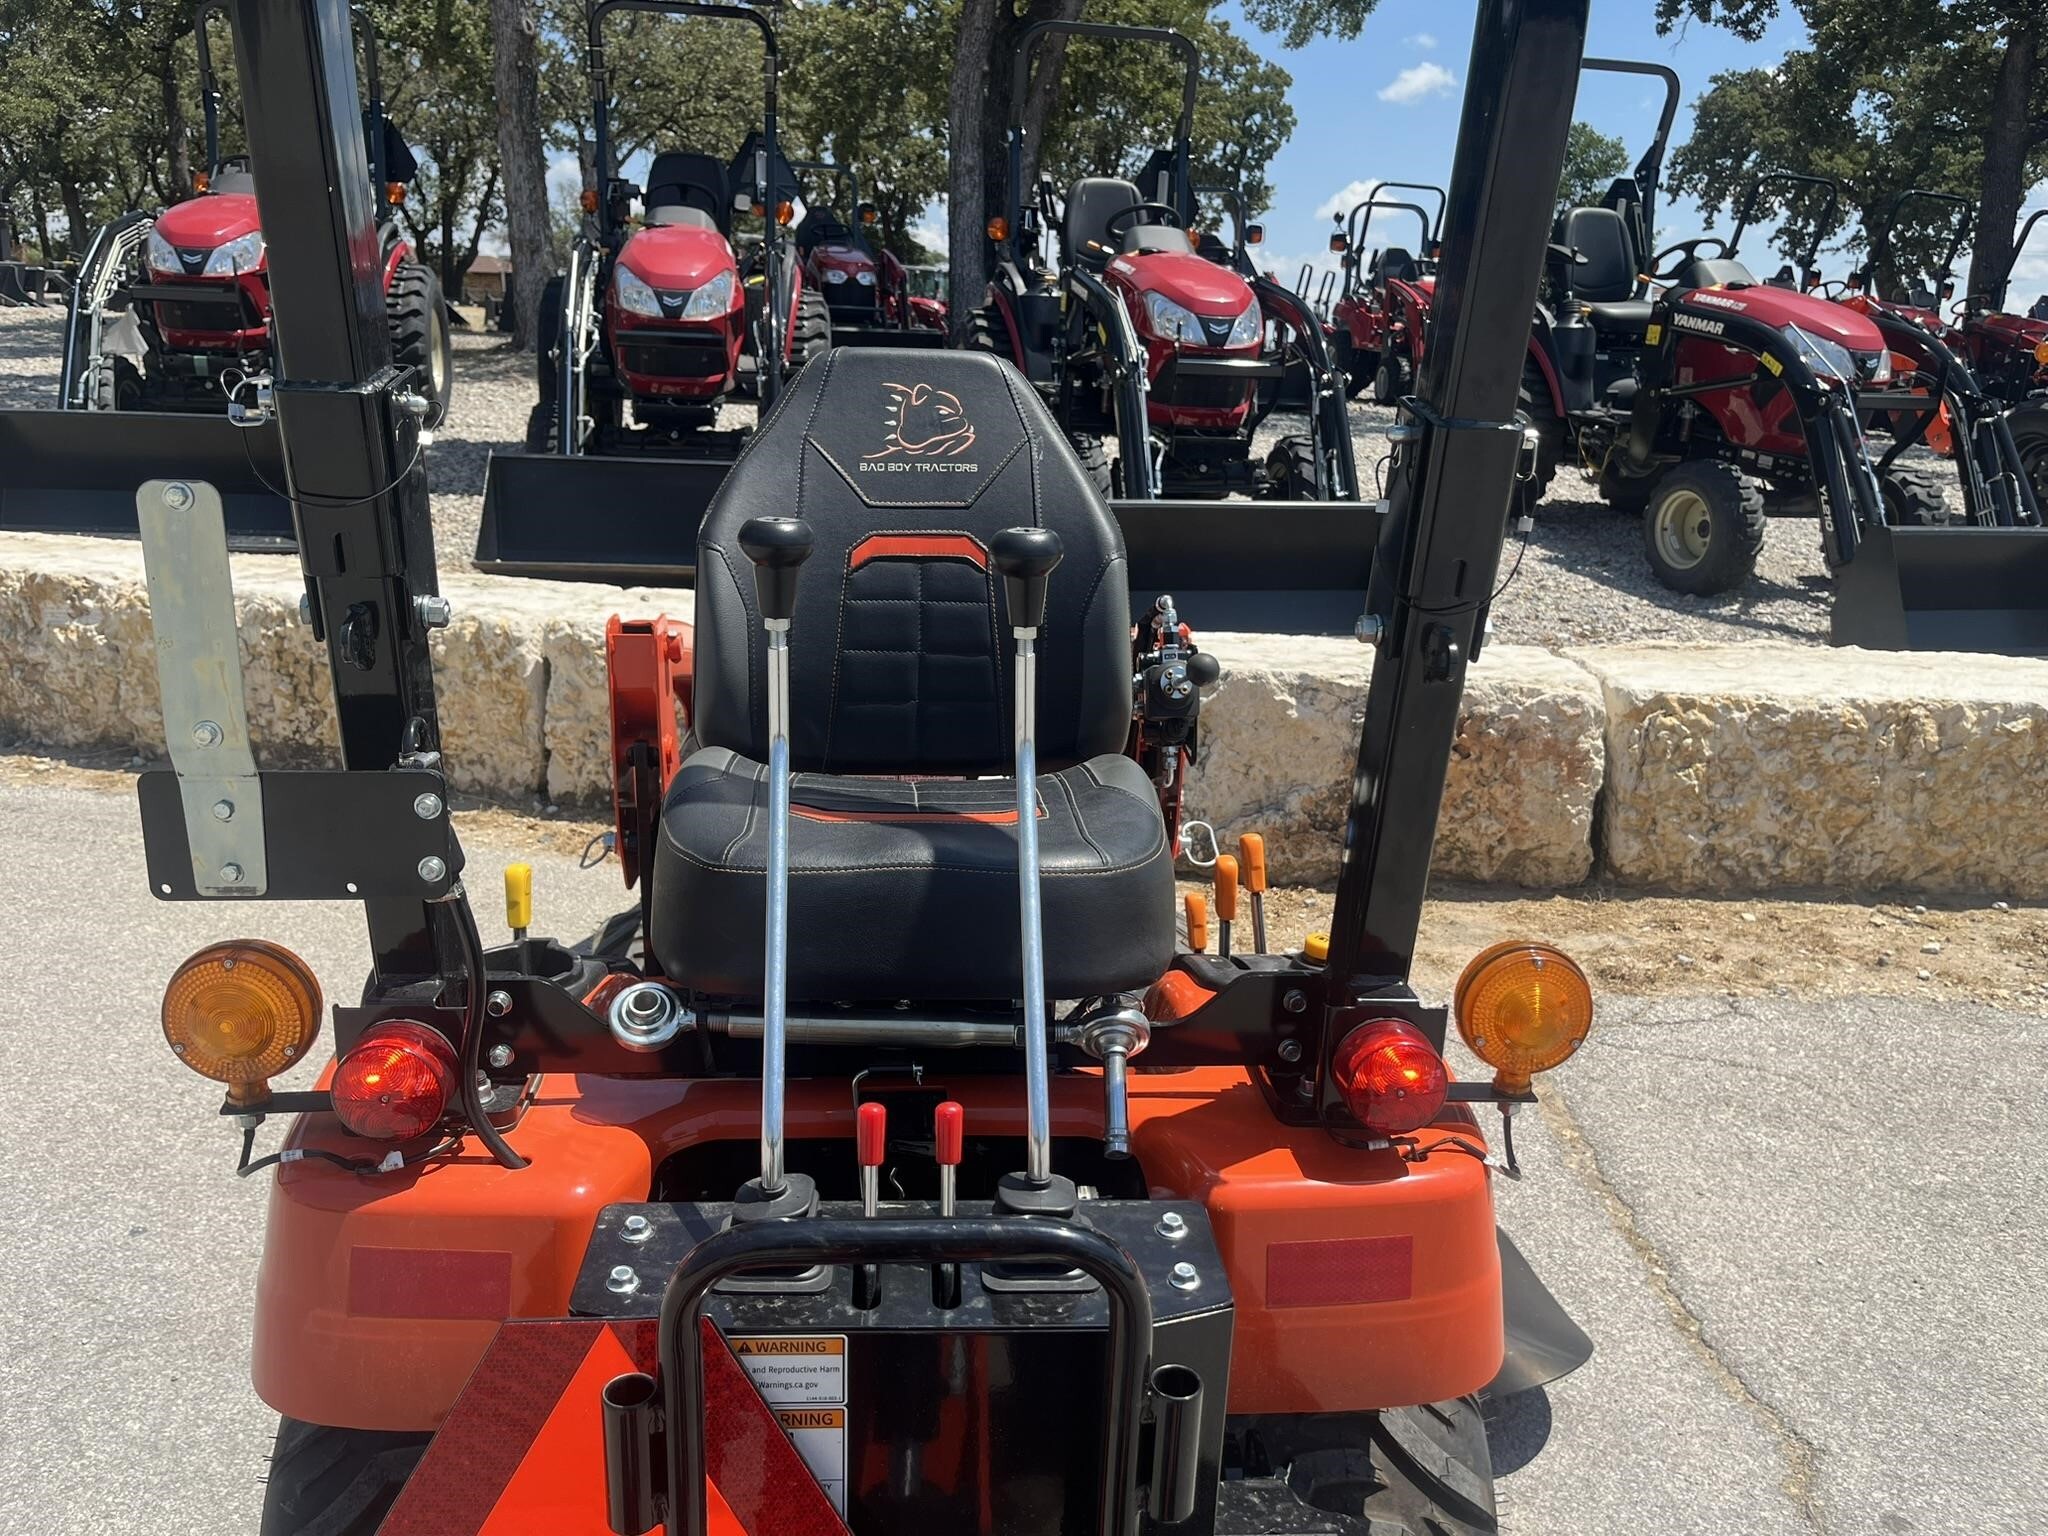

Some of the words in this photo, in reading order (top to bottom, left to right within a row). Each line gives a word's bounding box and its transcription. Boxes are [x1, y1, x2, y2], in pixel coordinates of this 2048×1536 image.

[1673, 312, 1725, 335] YANMAR
[859, 462, 885, 472] BAD
[887, 462, 912, 472] BOY
[914, 463, 978, 473] TRACTORS
[1819, 484, 1834, 532] YL210
[755, 1341, 827, 1353] WARNING
[751, 1366, 766, 1374] and
[768, 1365, 818, 1375] Reproductive
[819, 1365, 840, 1373] Harm
[781, 1412, 834, 1426] RNING
